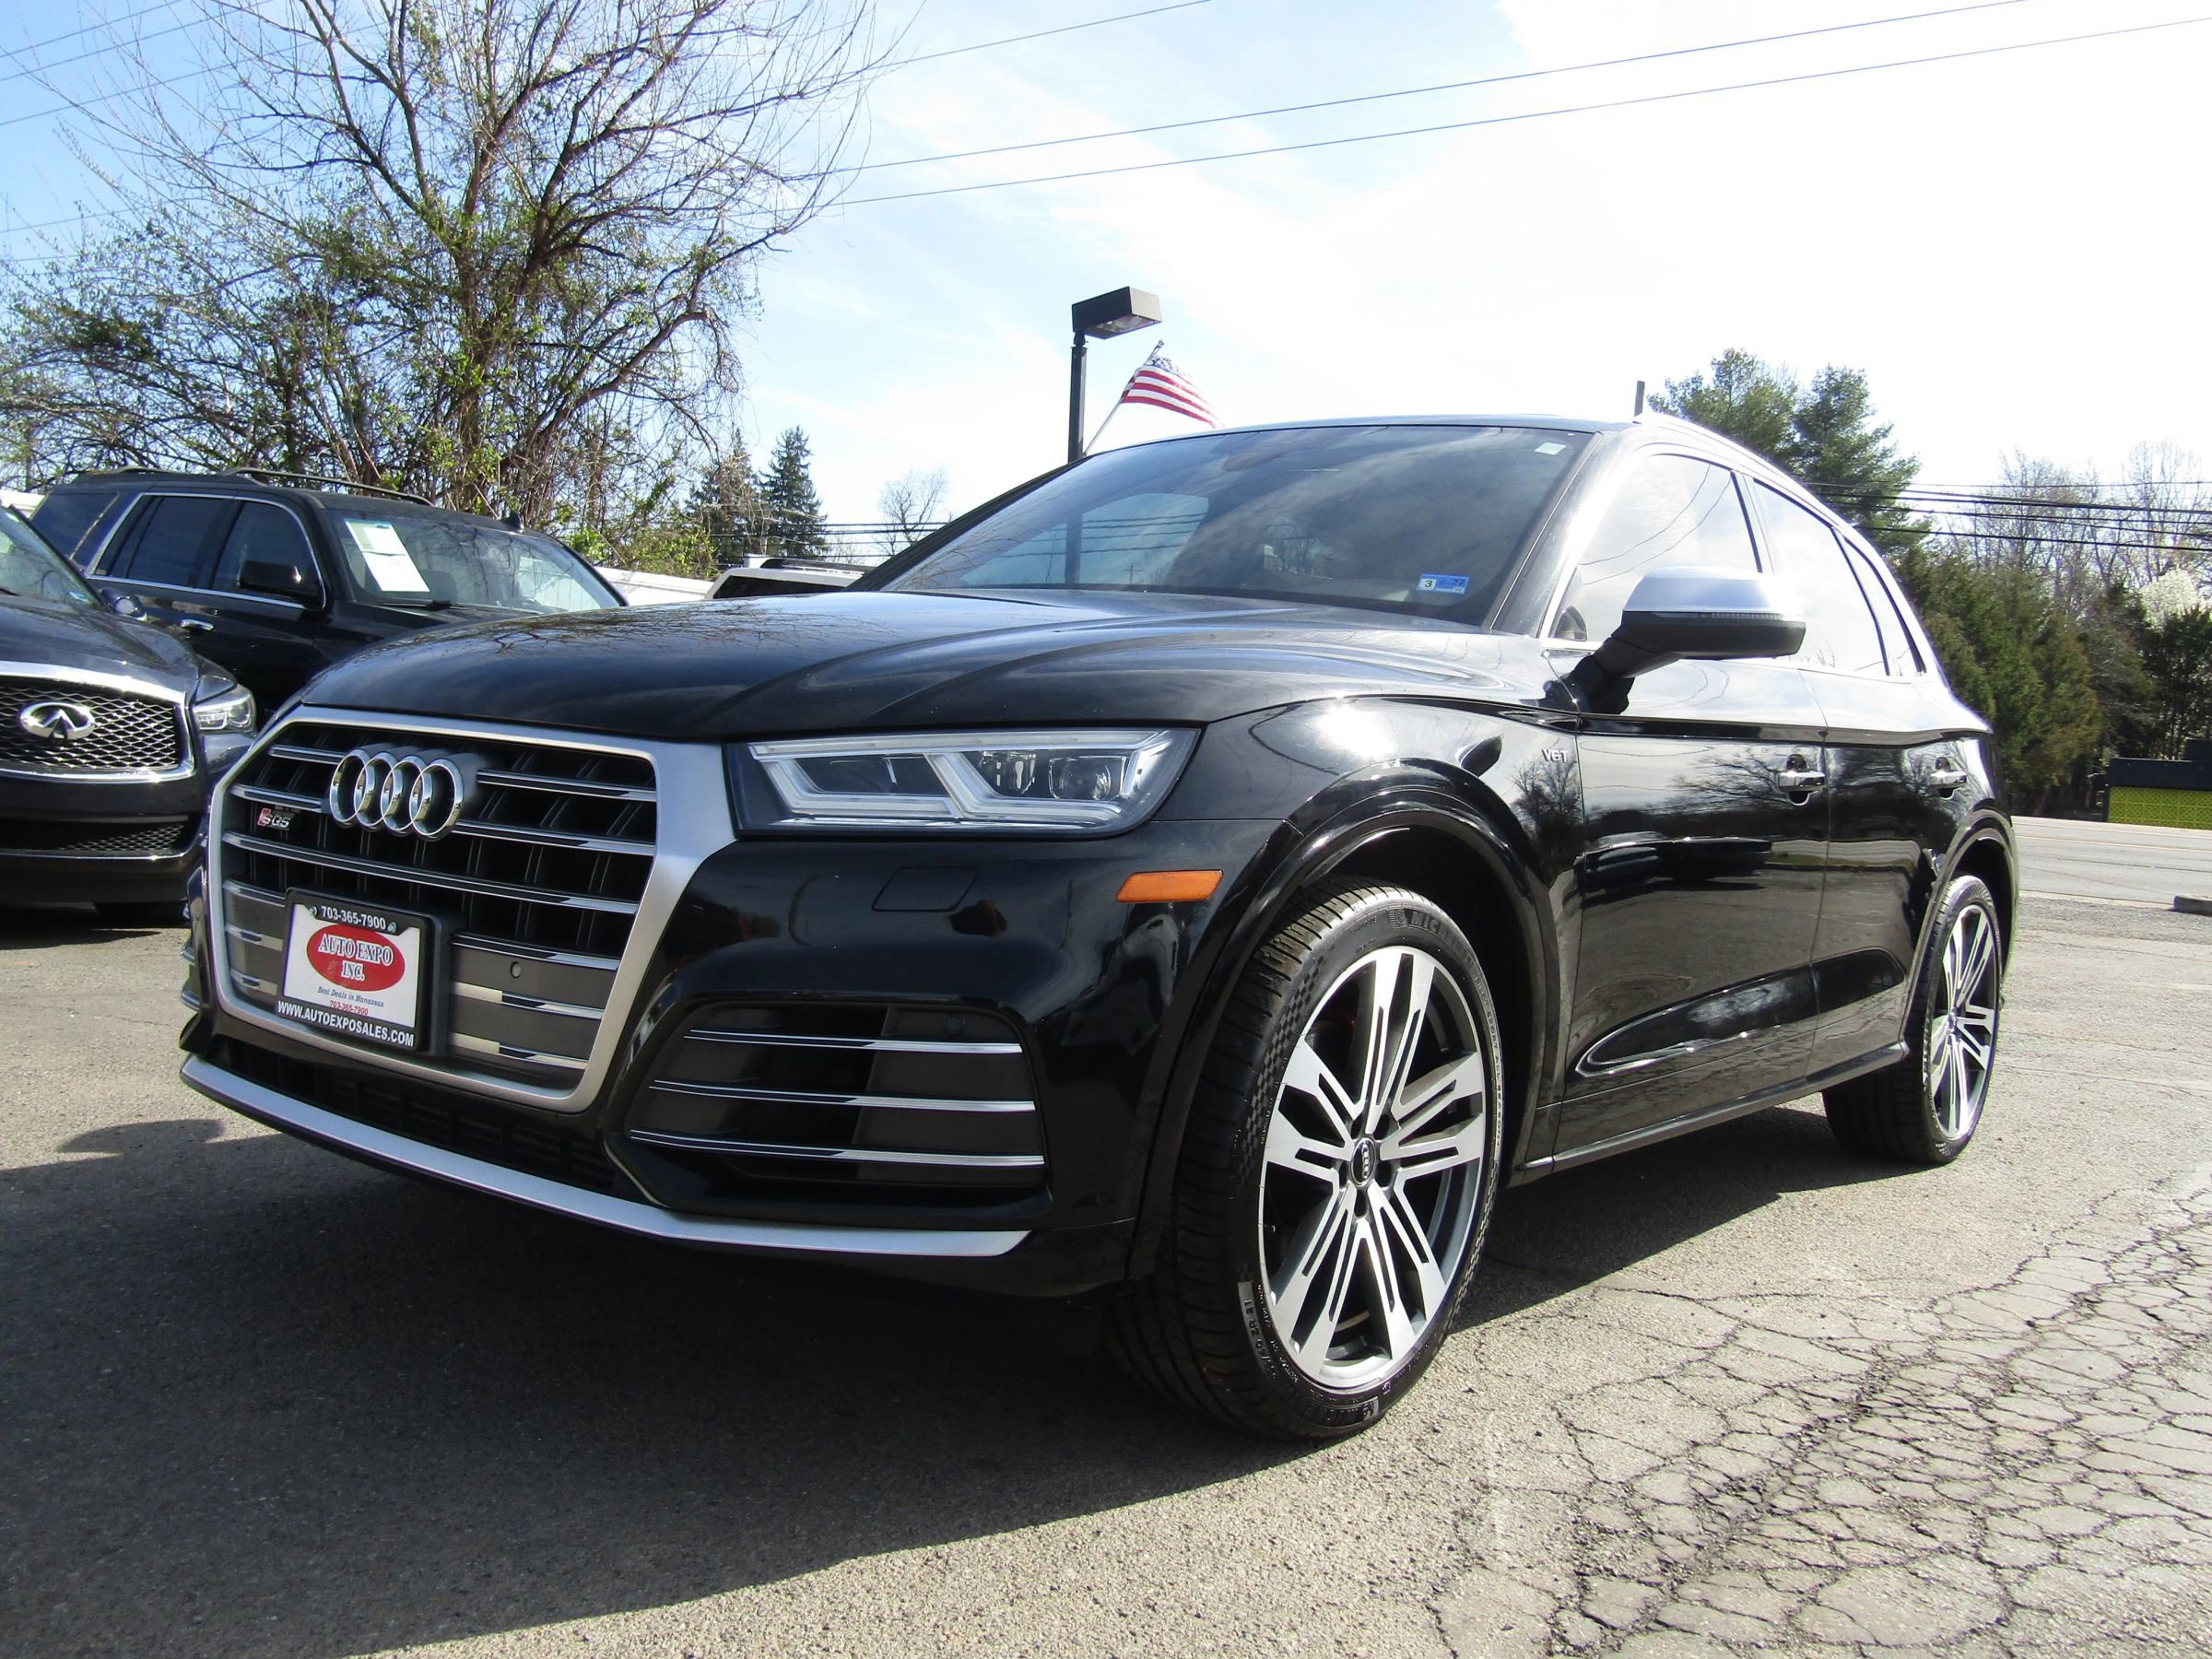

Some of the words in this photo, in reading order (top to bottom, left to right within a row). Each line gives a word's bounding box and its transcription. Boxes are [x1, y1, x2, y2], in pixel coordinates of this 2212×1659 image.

[1425, 580, 1432, 588] 3
[1541, 748, 1569, 763] V6T
[263, 815, 291, 829] SQ5
[321, 906, 386, 930] 703-365-7900
[1410, 911, 1476, 967] MICHELIN
[318, 934, 355, 958] AUTO
[356, 941, 394, 966] EXPO
[341, 960, 365, 981] INC.
[318, 986, 330, 995] Best
[331, 989, 347, 999] Deals
[355, 994, 384, 1007] Manassas
[330, 1000, 369, 1016] 703-365-7900
[278, 1000, 414, 1047] WWW.AUTOEXPOSALES.COM
